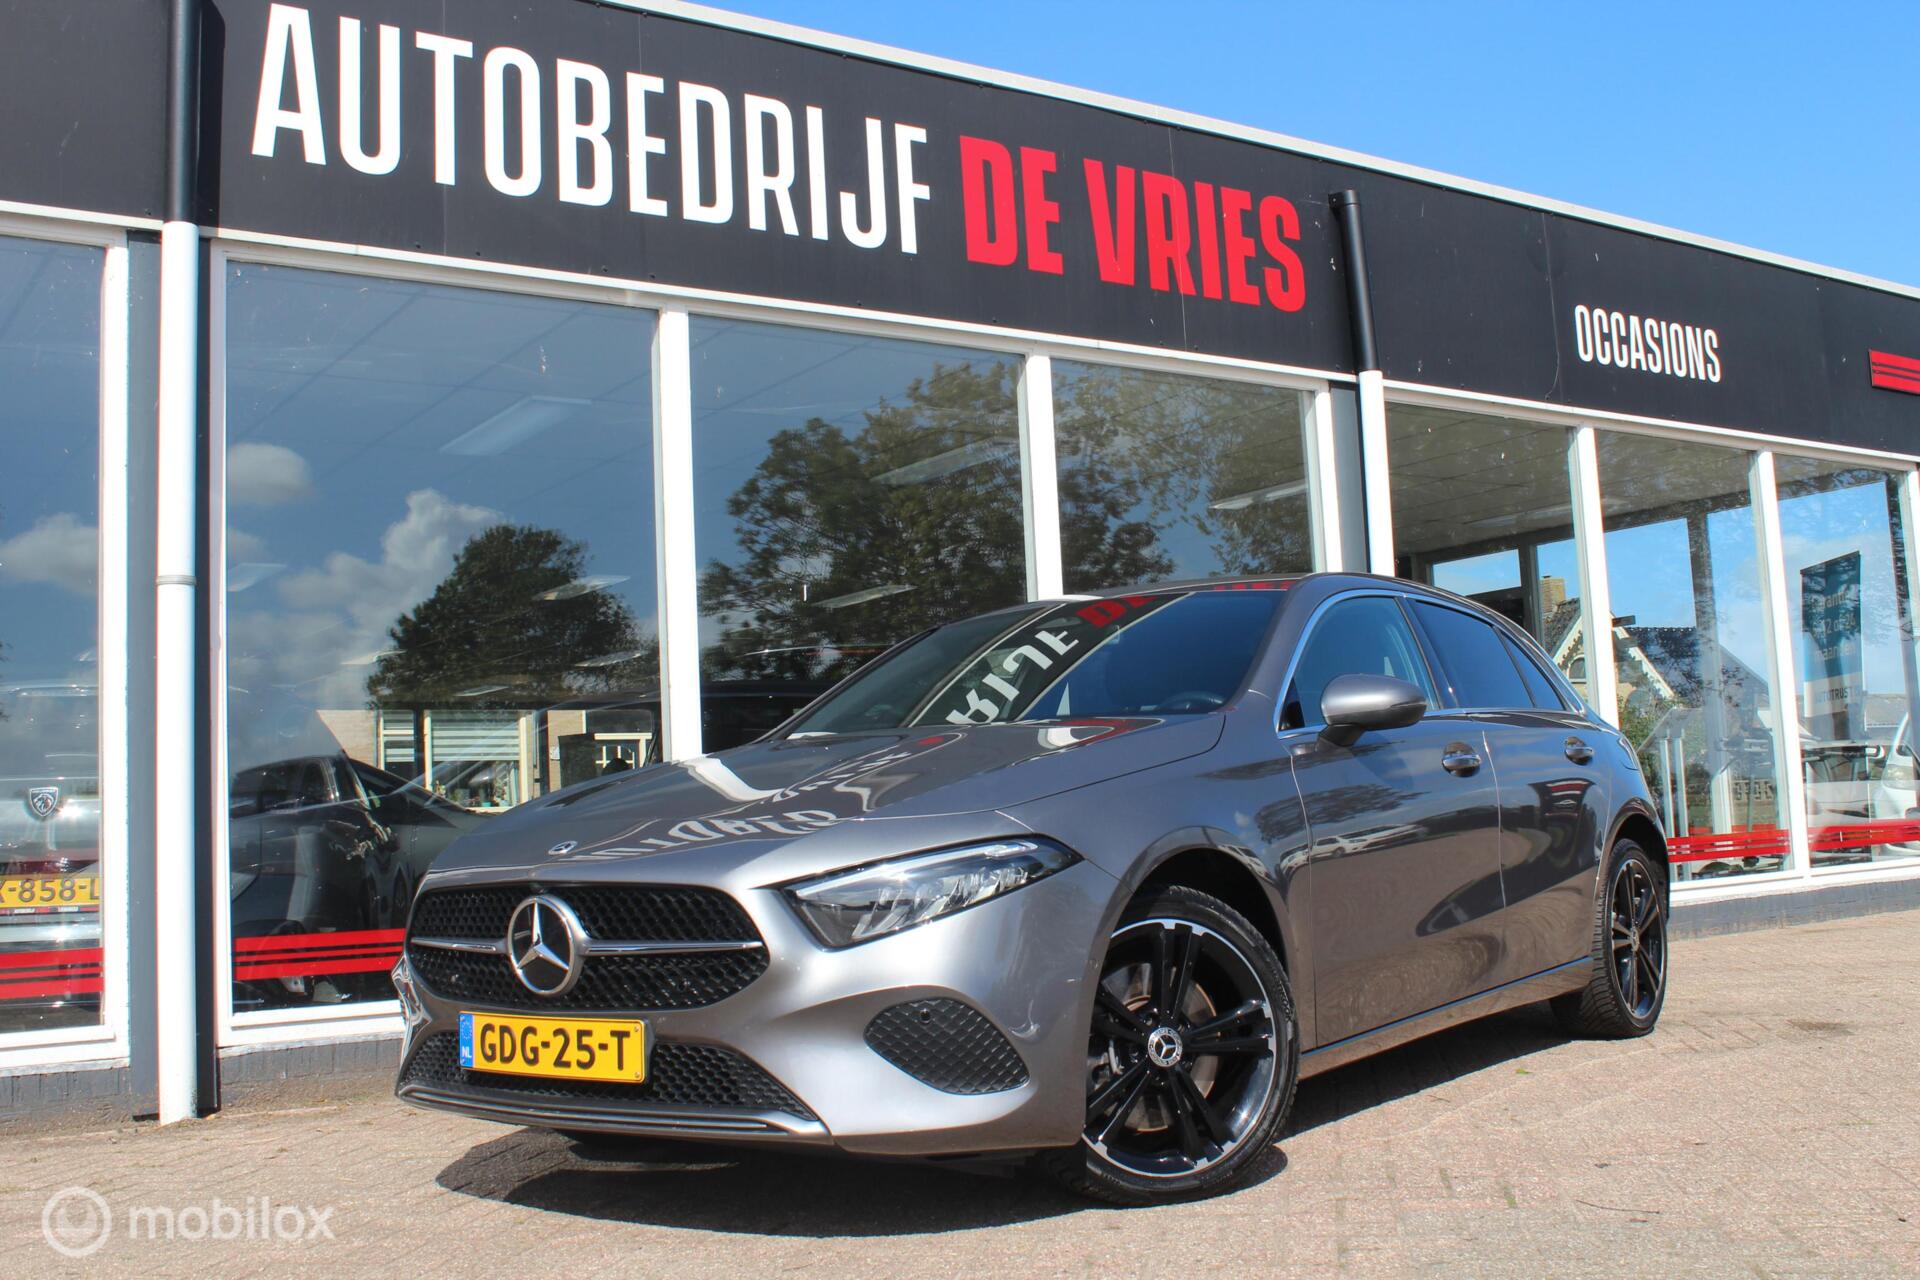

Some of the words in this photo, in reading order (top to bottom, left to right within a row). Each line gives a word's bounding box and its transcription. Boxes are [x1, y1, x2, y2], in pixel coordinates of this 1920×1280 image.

[251, 3, 931, 256] AUTOBEDRIJF
[959, 135, 1065, 276] DE
[1083, 158, 1306, 313] VRIES
[1574, 303, 1722, 384] OCCASIONS
[461, 1046, 472, 1058] NL
[479, 1022, 631, 1071] GDG-25-T
